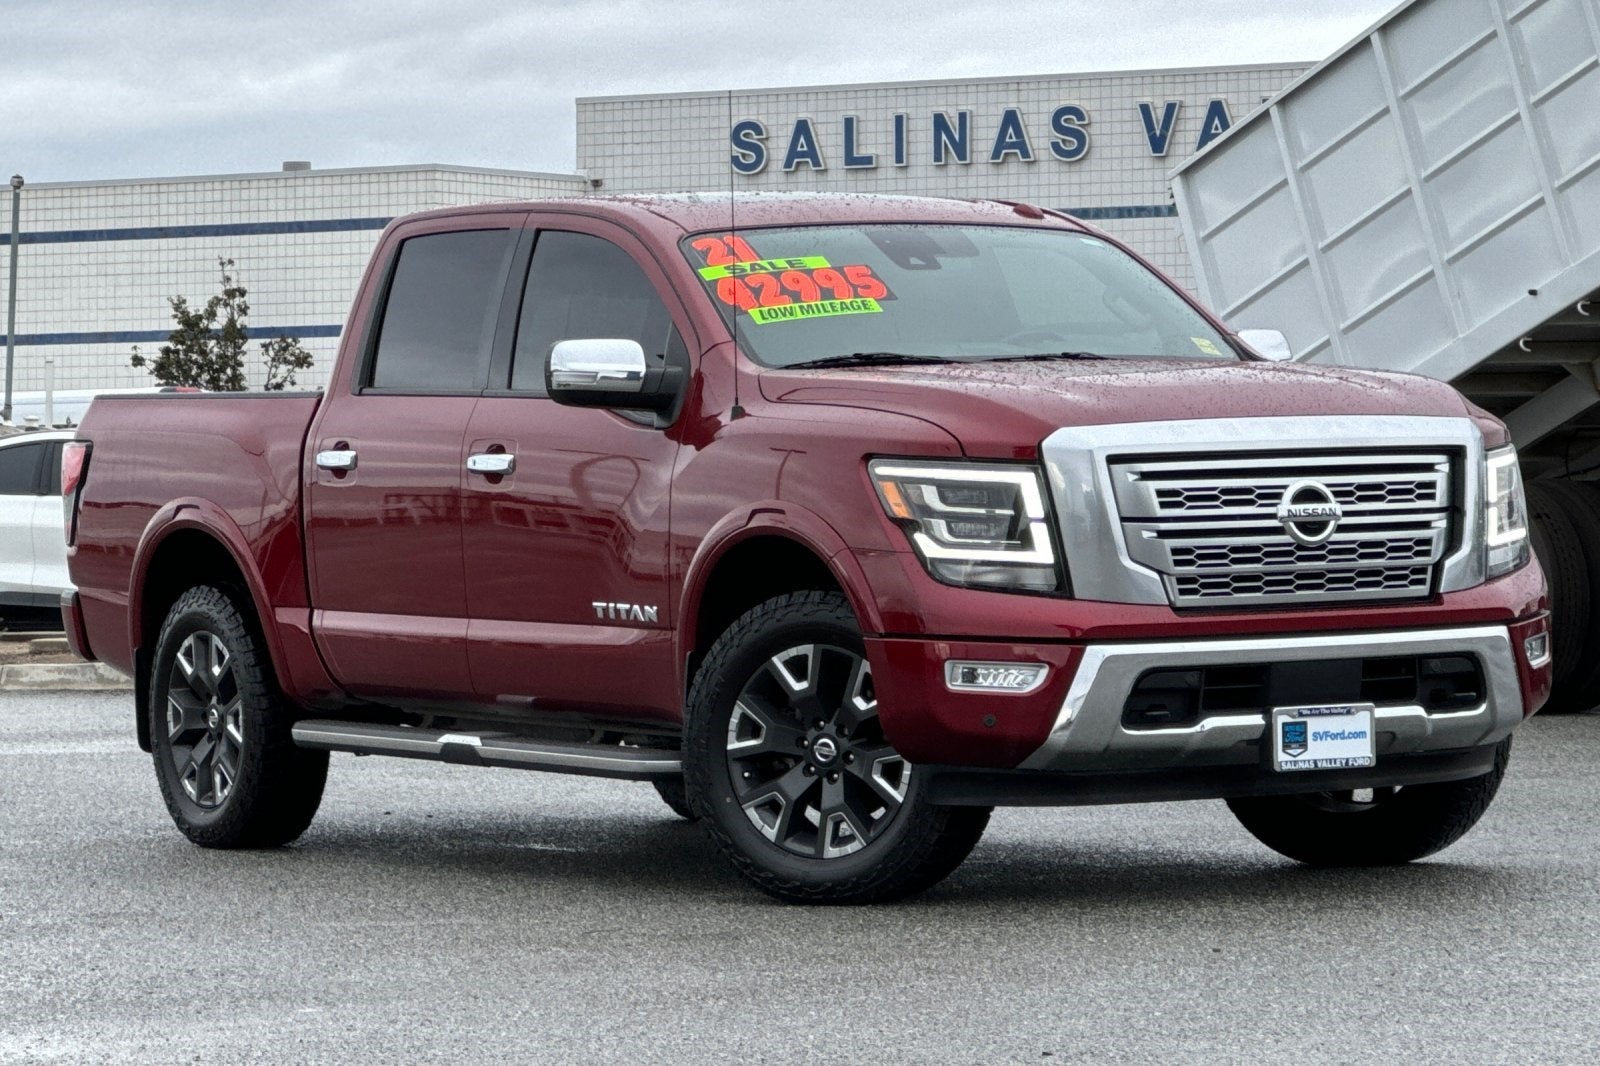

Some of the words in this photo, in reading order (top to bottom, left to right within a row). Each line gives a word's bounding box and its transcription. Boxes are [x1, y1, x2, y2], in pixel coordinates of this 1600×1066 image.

[731, 104, 1090, 175] SALINAS
[691, 235, 760, 266] 21
[723, 258, 808, 274] SALE
[717, 264, 887, 310] 42995
[759, 305, 796, 321] LOW
[800, 299, 873, 315] MILEAGE
[1287, 507, 1337, 518] NISSAN
[592, 601, 658, 623] TITAN
[1312, 729, 1367, 742] SVFord.com
[1281, 760, 1315, 770] SALINAS
[1316, 759, 1346, 769] VALLEY
[1348, 757, 1371, 767] FORD
